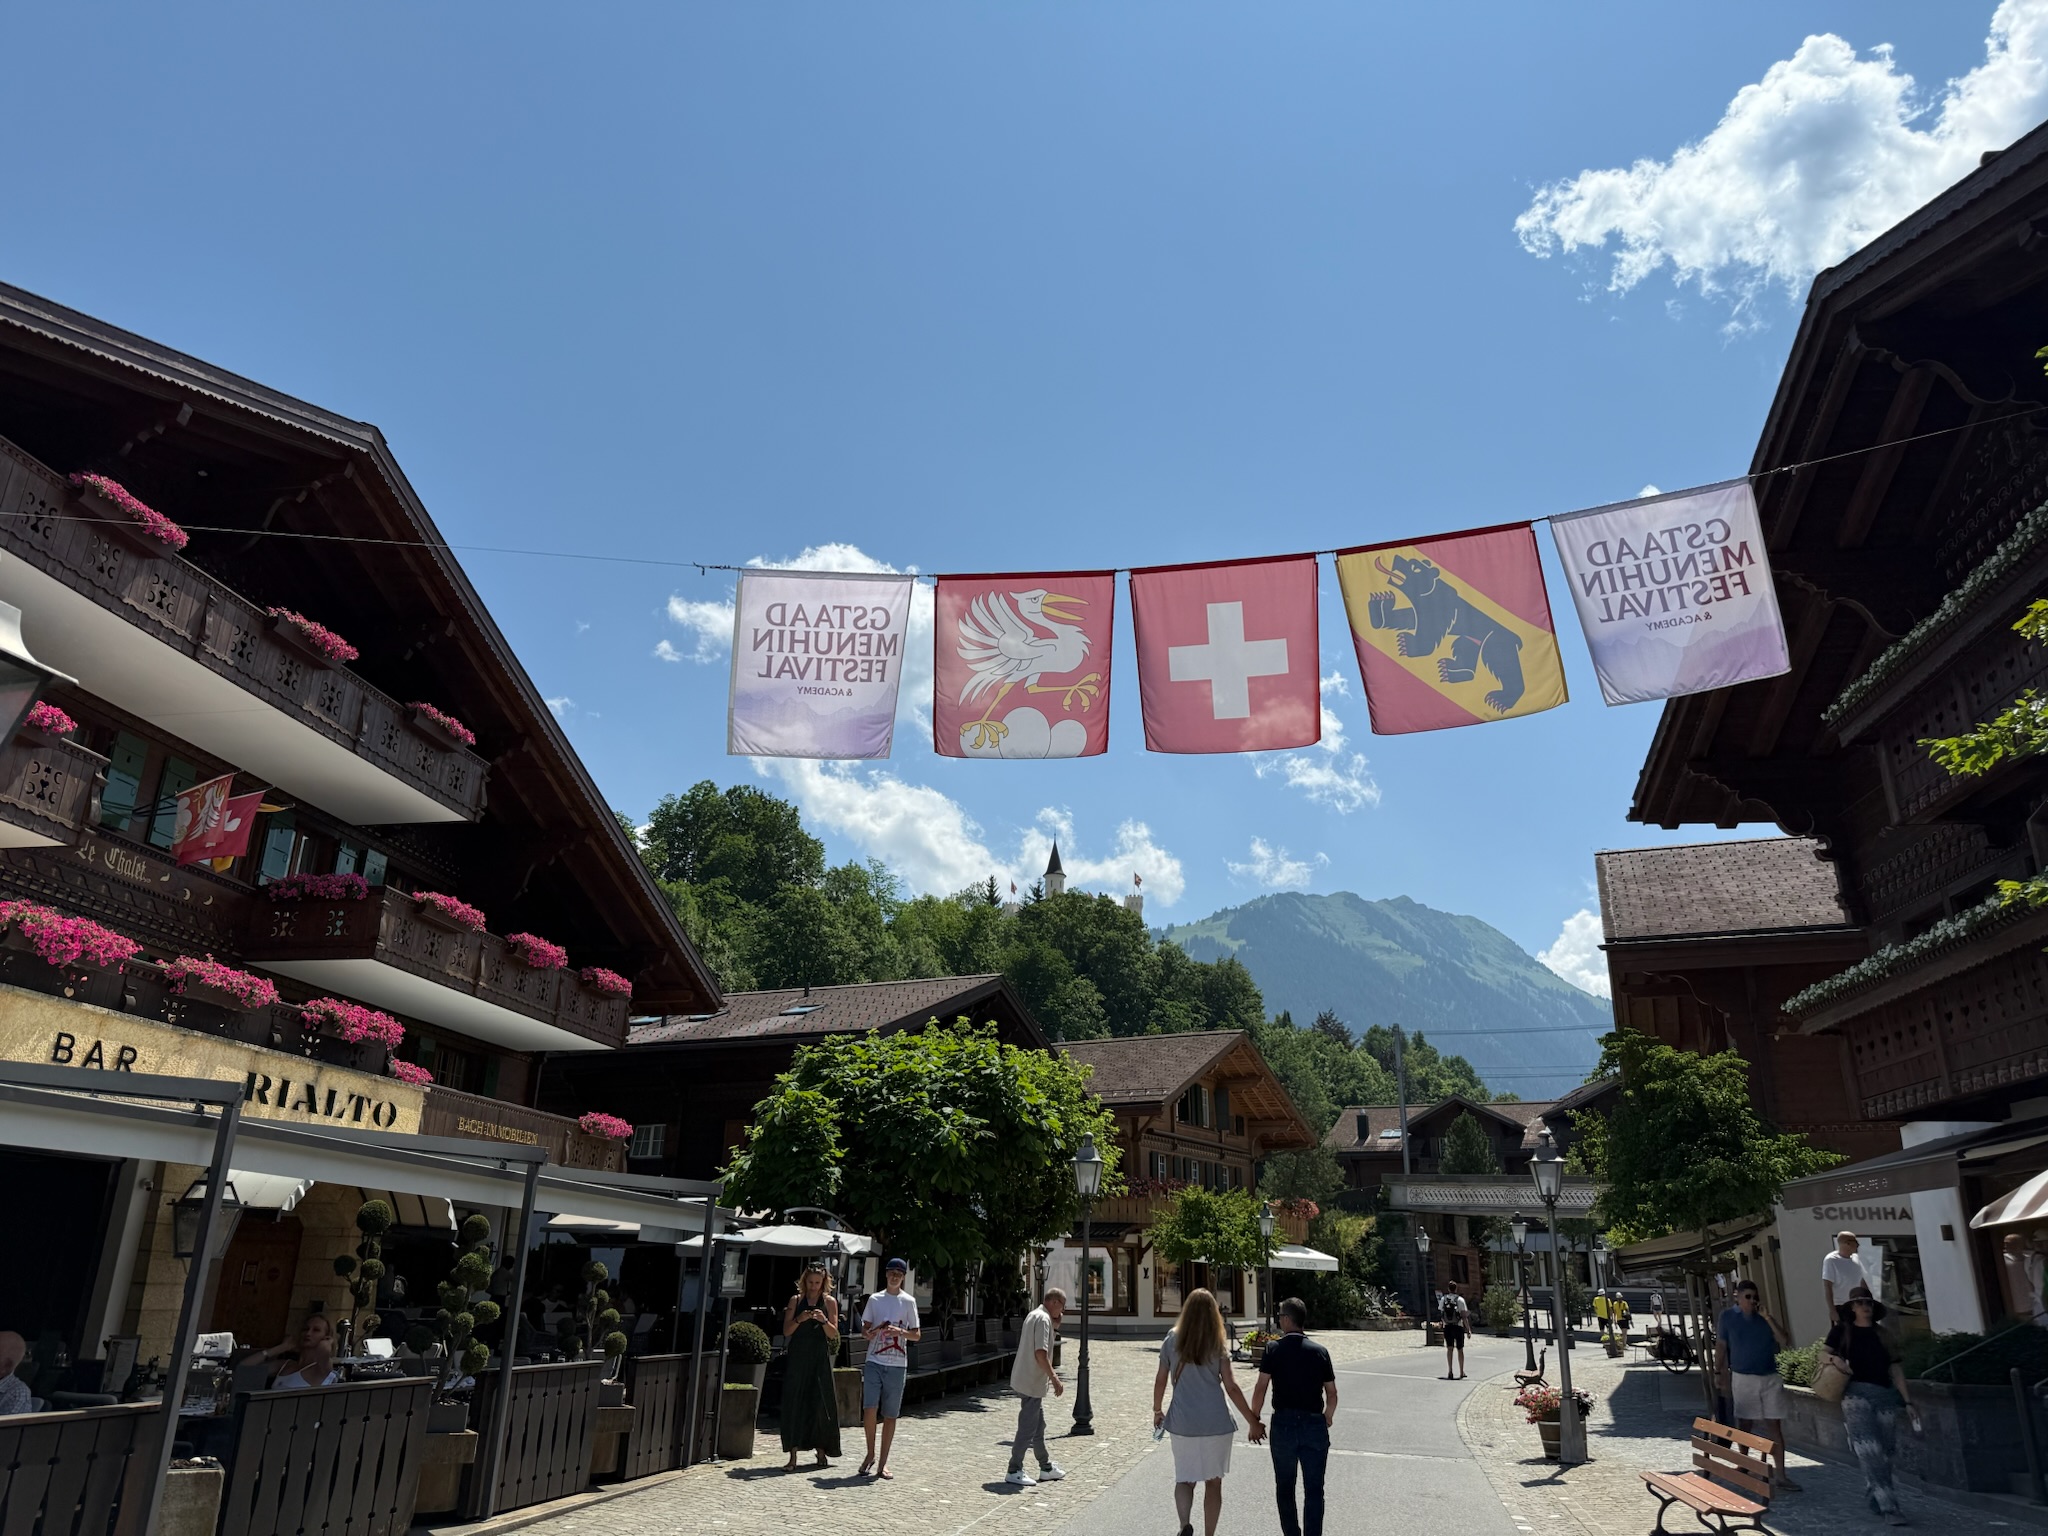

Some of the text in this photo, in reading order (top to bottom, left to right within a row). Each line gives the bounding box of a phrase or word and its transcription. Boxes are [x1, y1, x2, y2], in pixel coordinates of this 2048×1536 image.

[51, 1031, 138, 1072] BAR
[243, 1071, 398, 1128] RIALTO
[1812, 1206, 1913, 1221] SCHUHHA
